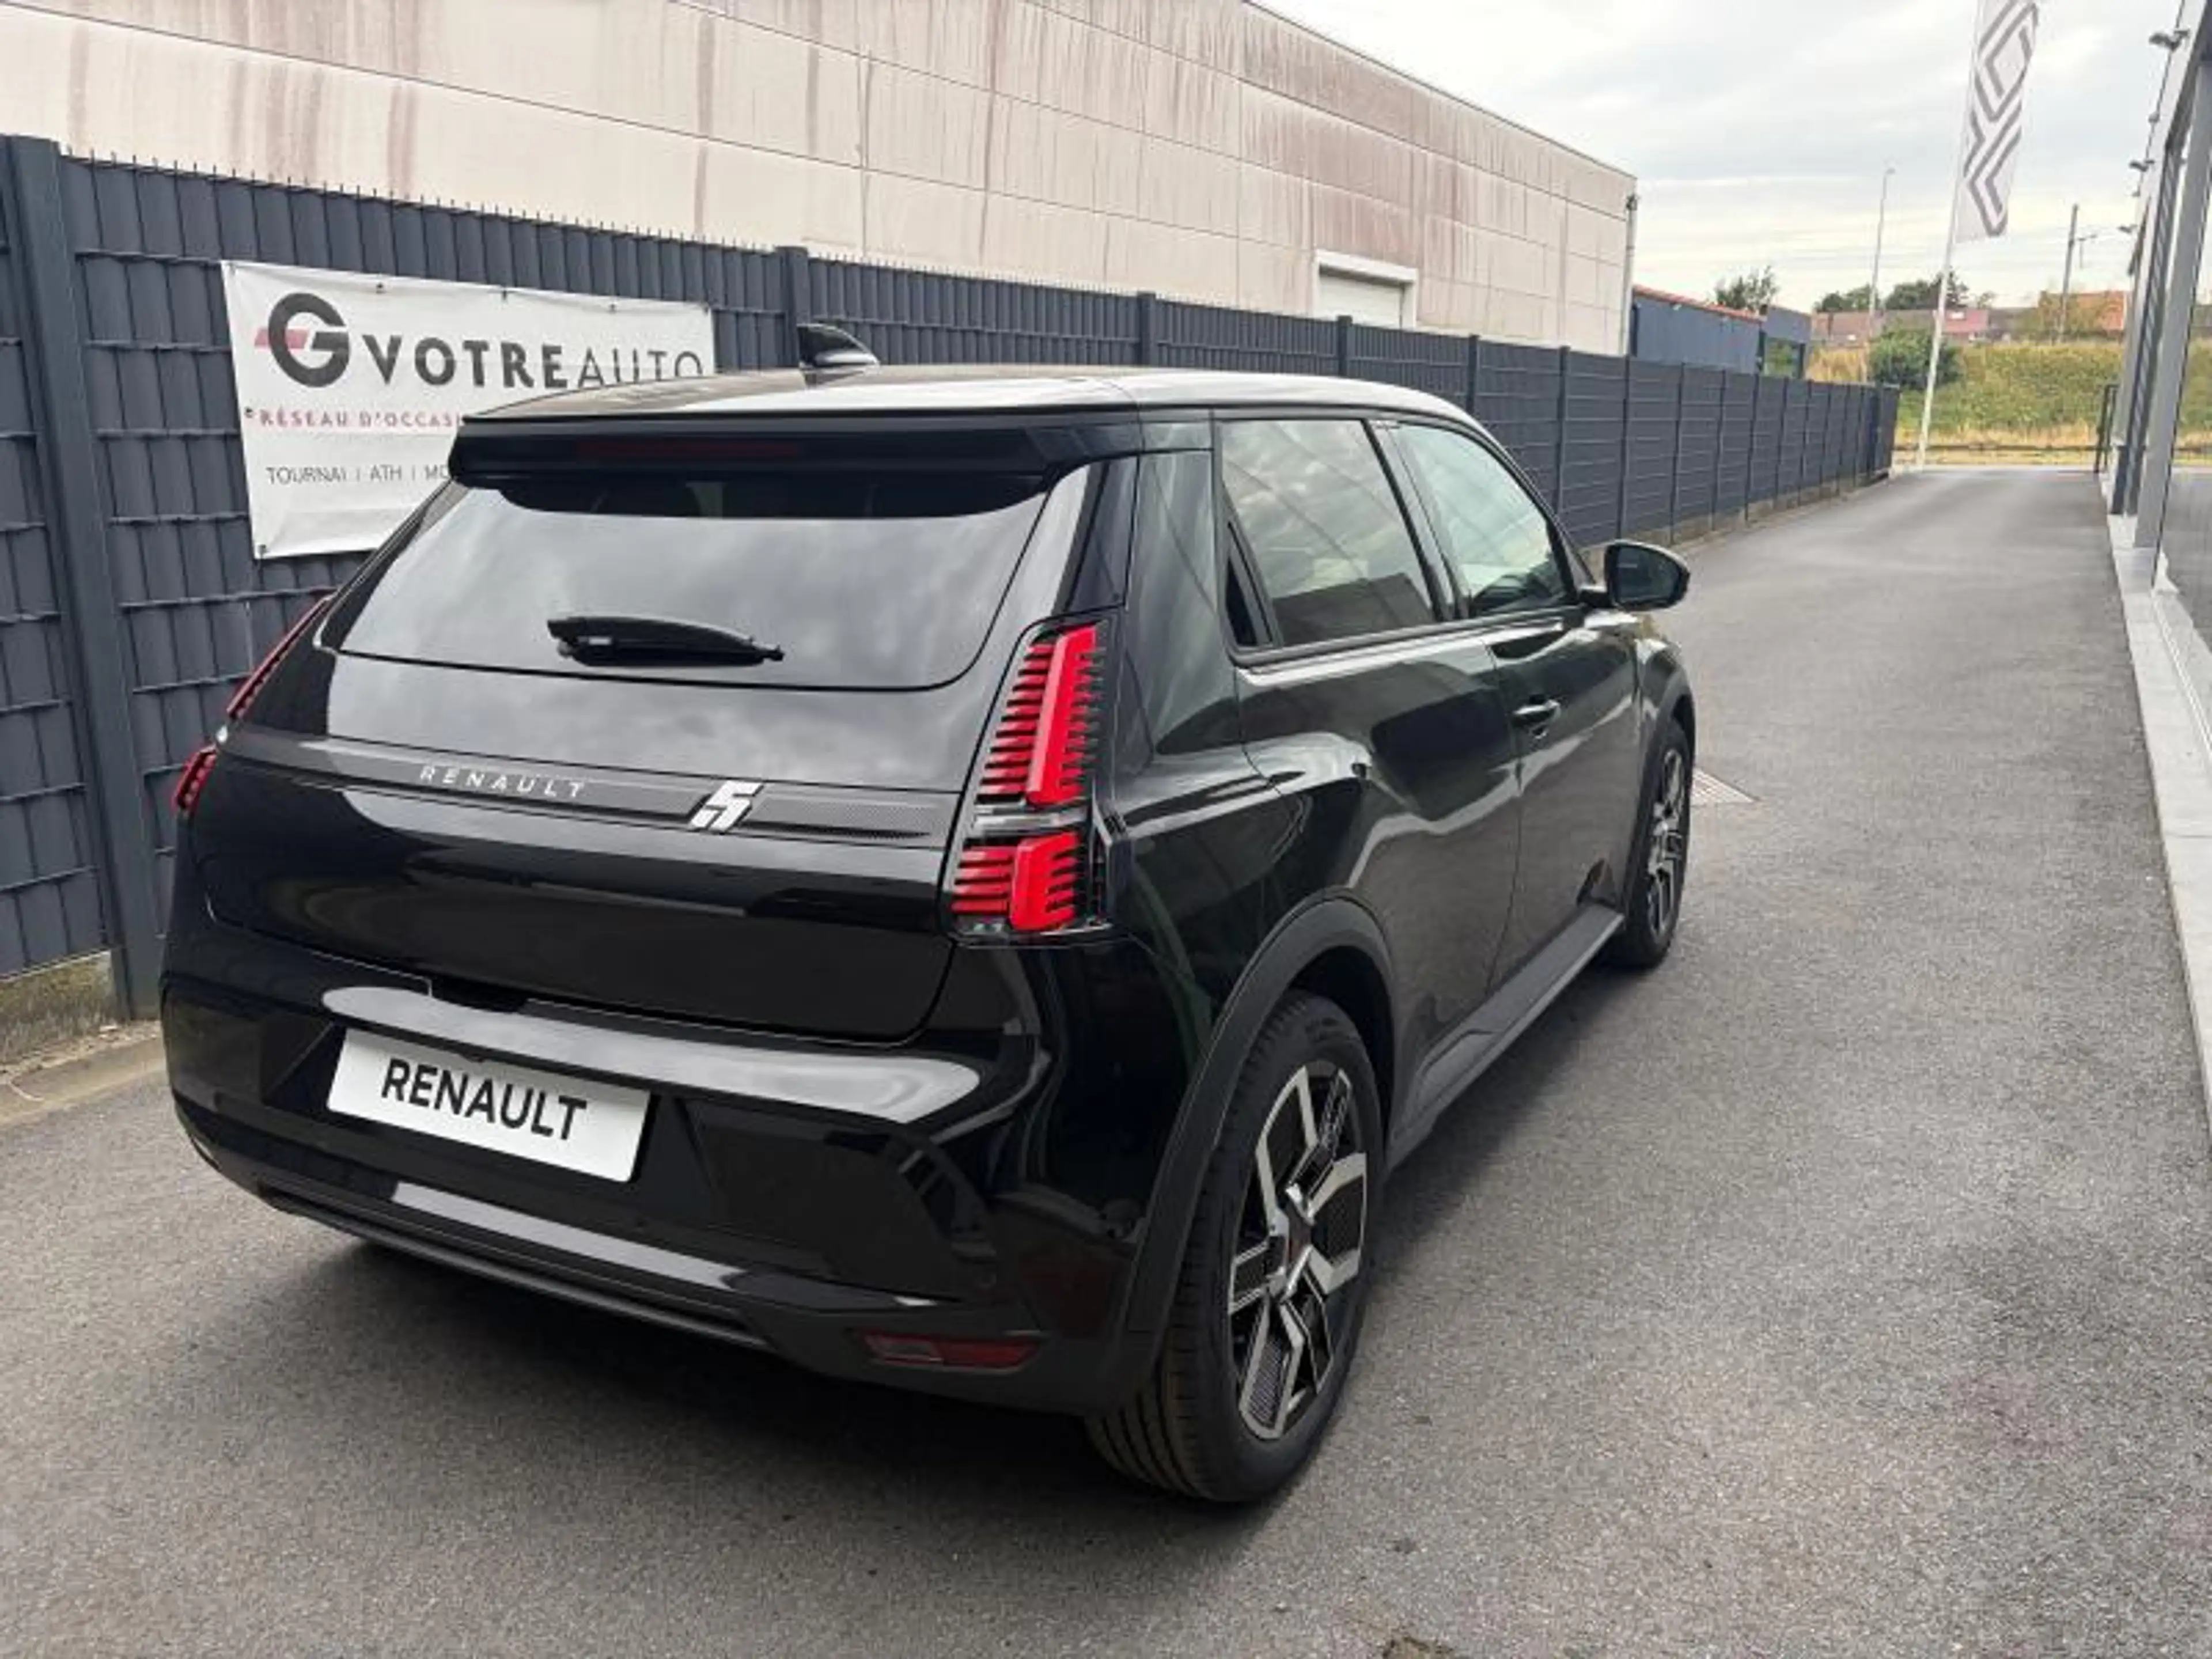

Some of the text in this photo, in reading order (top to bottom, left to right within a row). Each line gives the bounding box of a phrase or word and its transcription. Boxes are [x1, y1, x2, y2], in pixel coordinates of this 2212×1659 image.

[260, 405, 347, 427] RÉSEAU
[266, 465, 346, 486] TOURNAI
[370, 464, 402, 482] ATH
[419, 765, 585, 798] RENAULT
[381, 1058, 588, 1140] RENAULT
